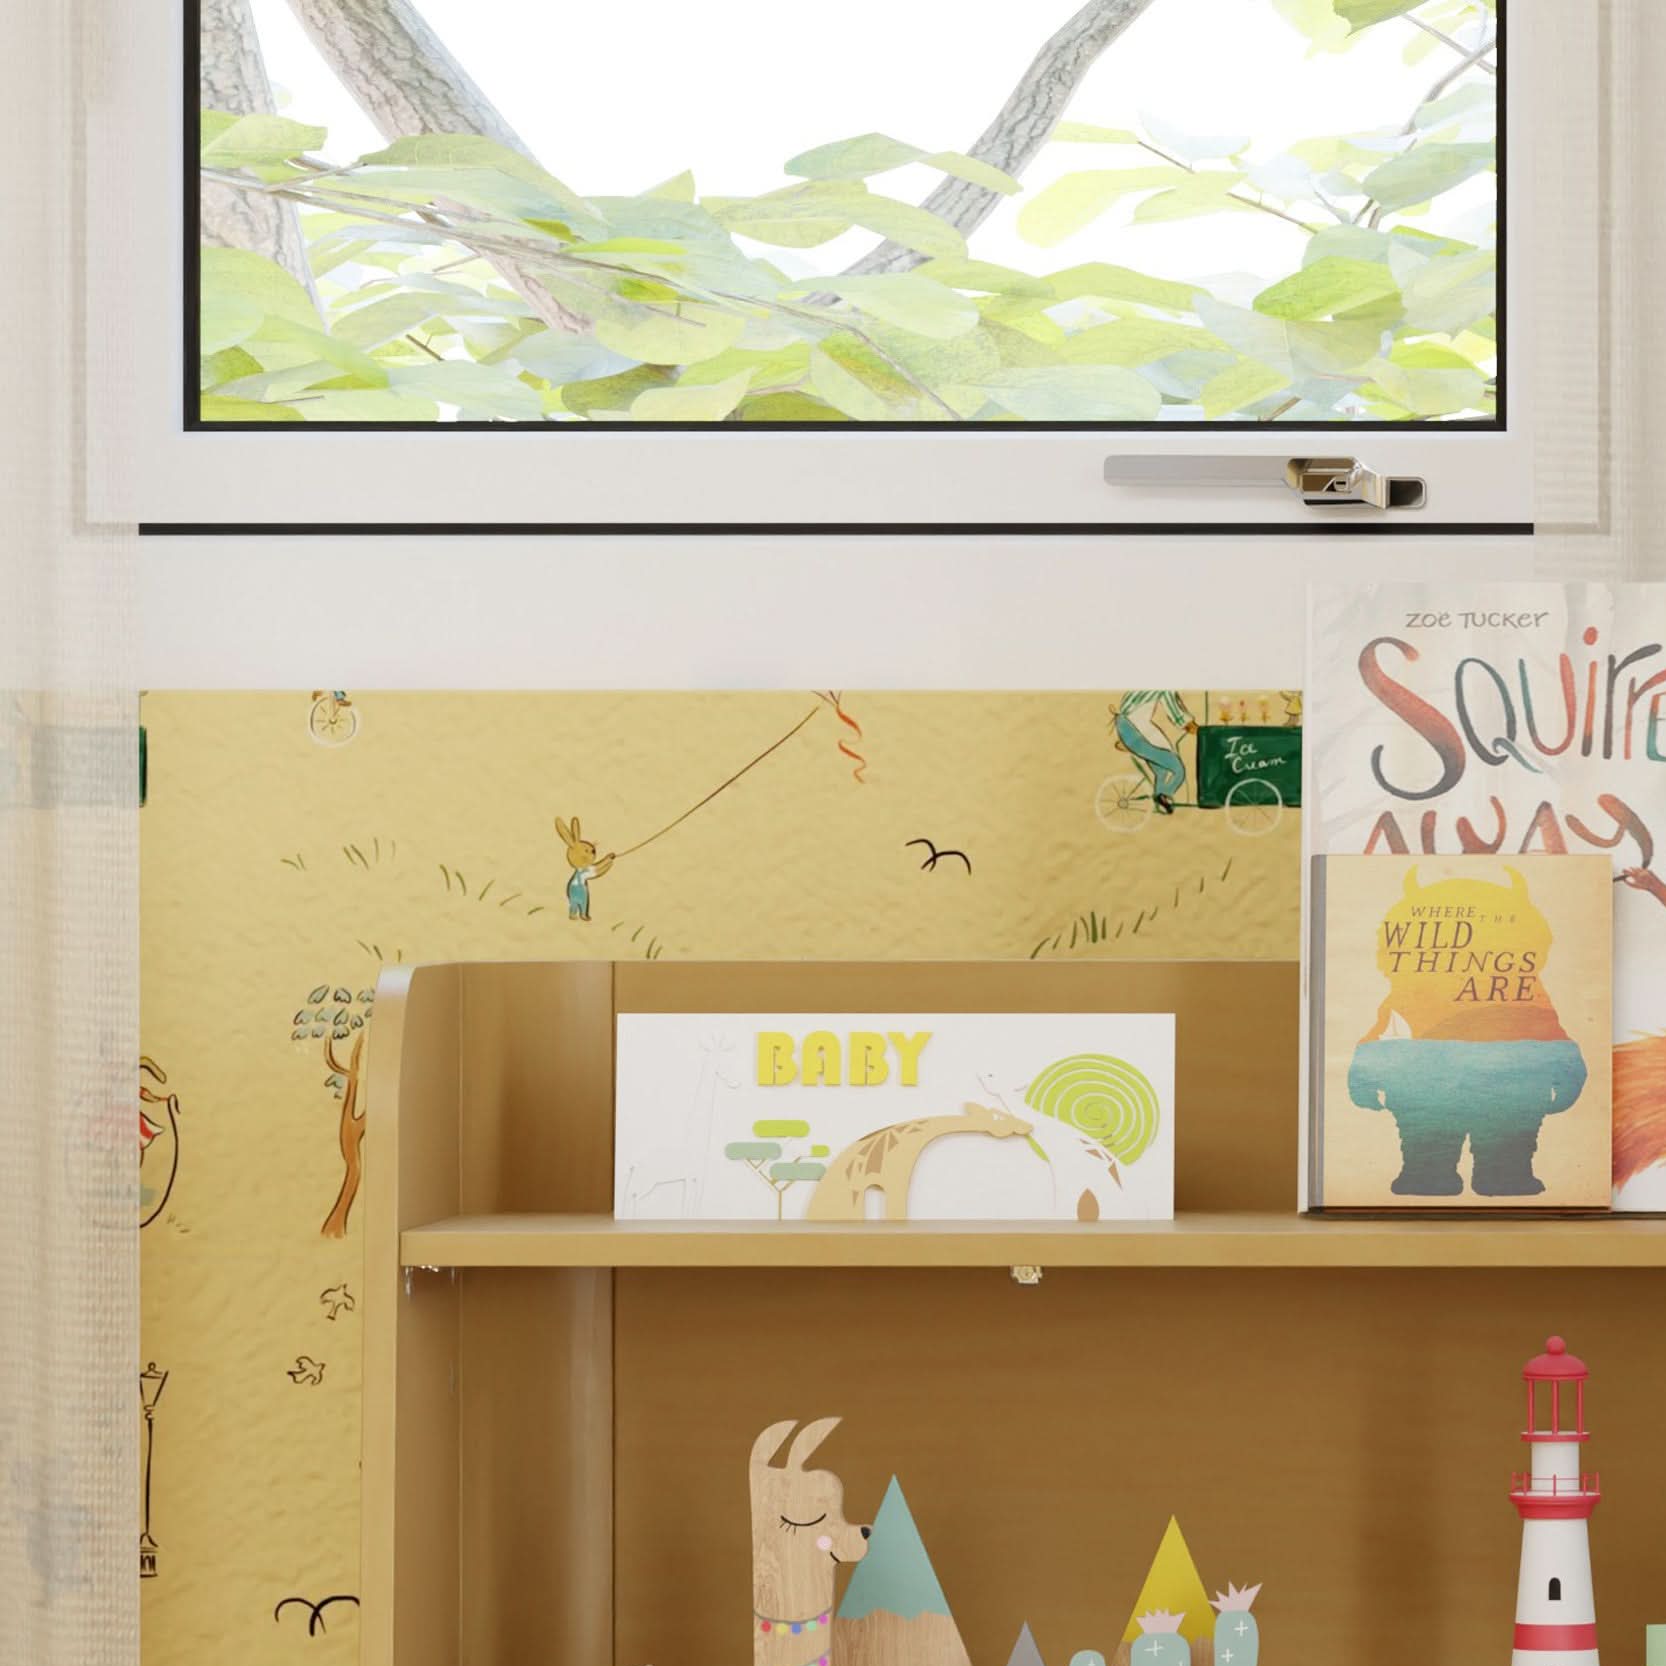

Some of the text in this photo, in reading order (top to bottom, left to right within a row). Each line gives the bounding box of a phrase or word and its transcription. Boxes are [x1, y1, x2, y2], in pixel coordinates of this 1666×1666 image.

[1411, 905, 1477, 919] WHERE
[1384, 921, 1474, 949] WILD
[1389, 951, 1537, 973] THINGS
[1453, 975, 1538, 1002] ARE
[756, 1030, 934, 1088] BABY
